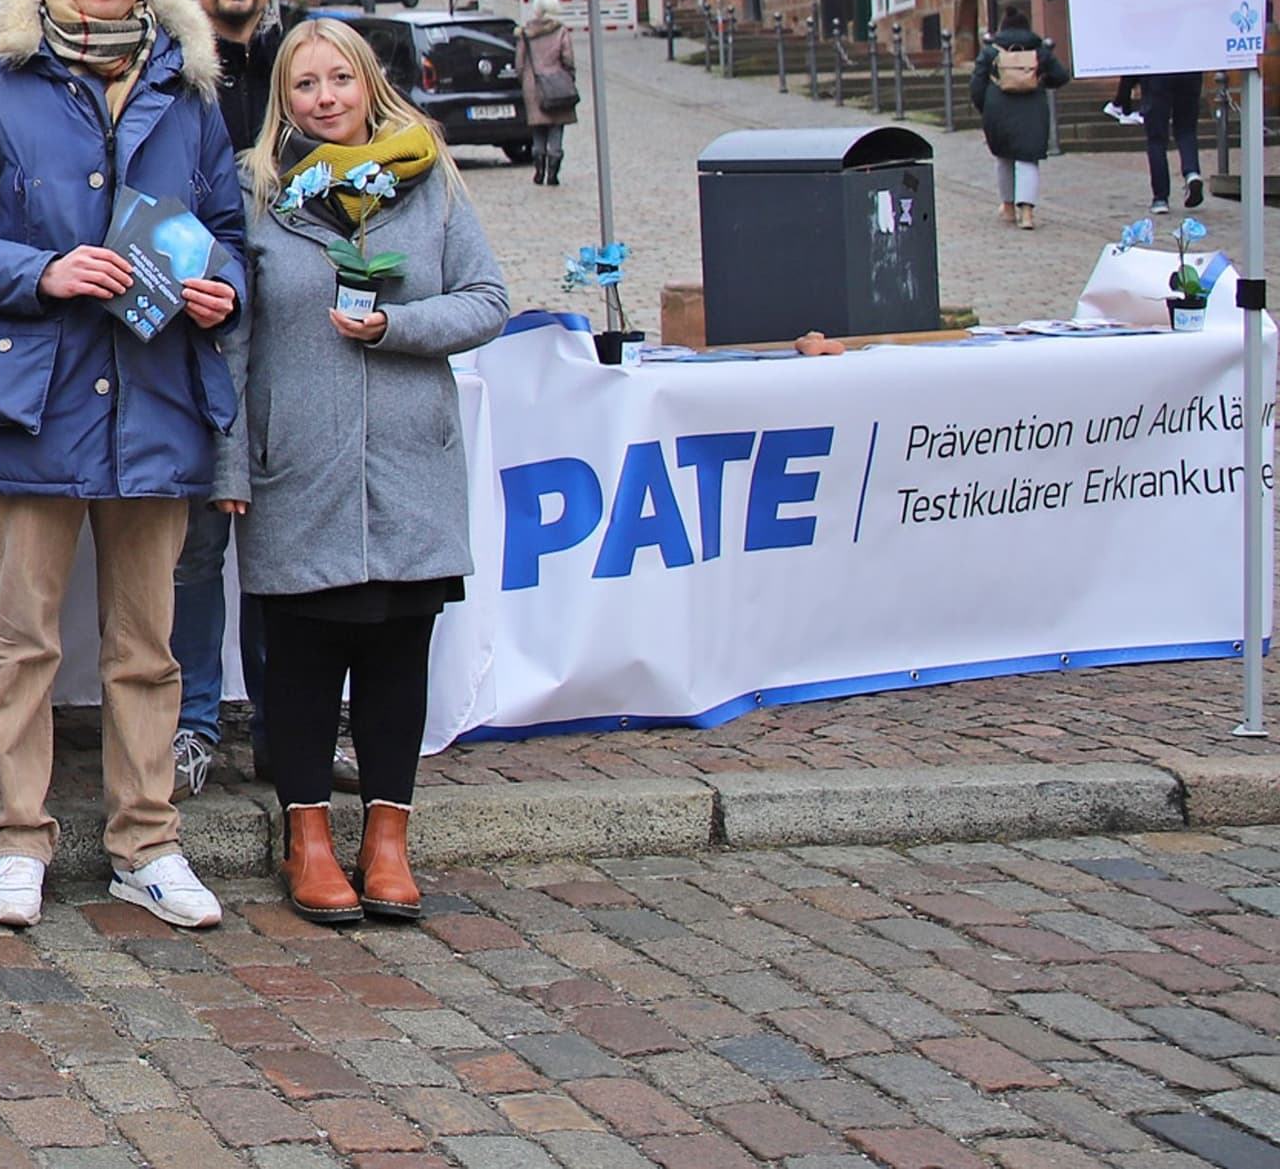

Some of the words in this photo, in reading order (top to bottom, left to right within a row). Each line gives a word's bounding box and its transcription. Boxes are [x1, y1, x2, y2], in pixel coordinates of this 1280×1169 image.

[1226, 36, 1262, 52] PATE
[905, 414, 1073, 462] Prävention
[1084, 404, 1144, 445] und
[1147, 394, 1275, 436] Aufklä
[499, 426, 835, 591] PATE
[897, 478, 1073, 524] Testikulärer
